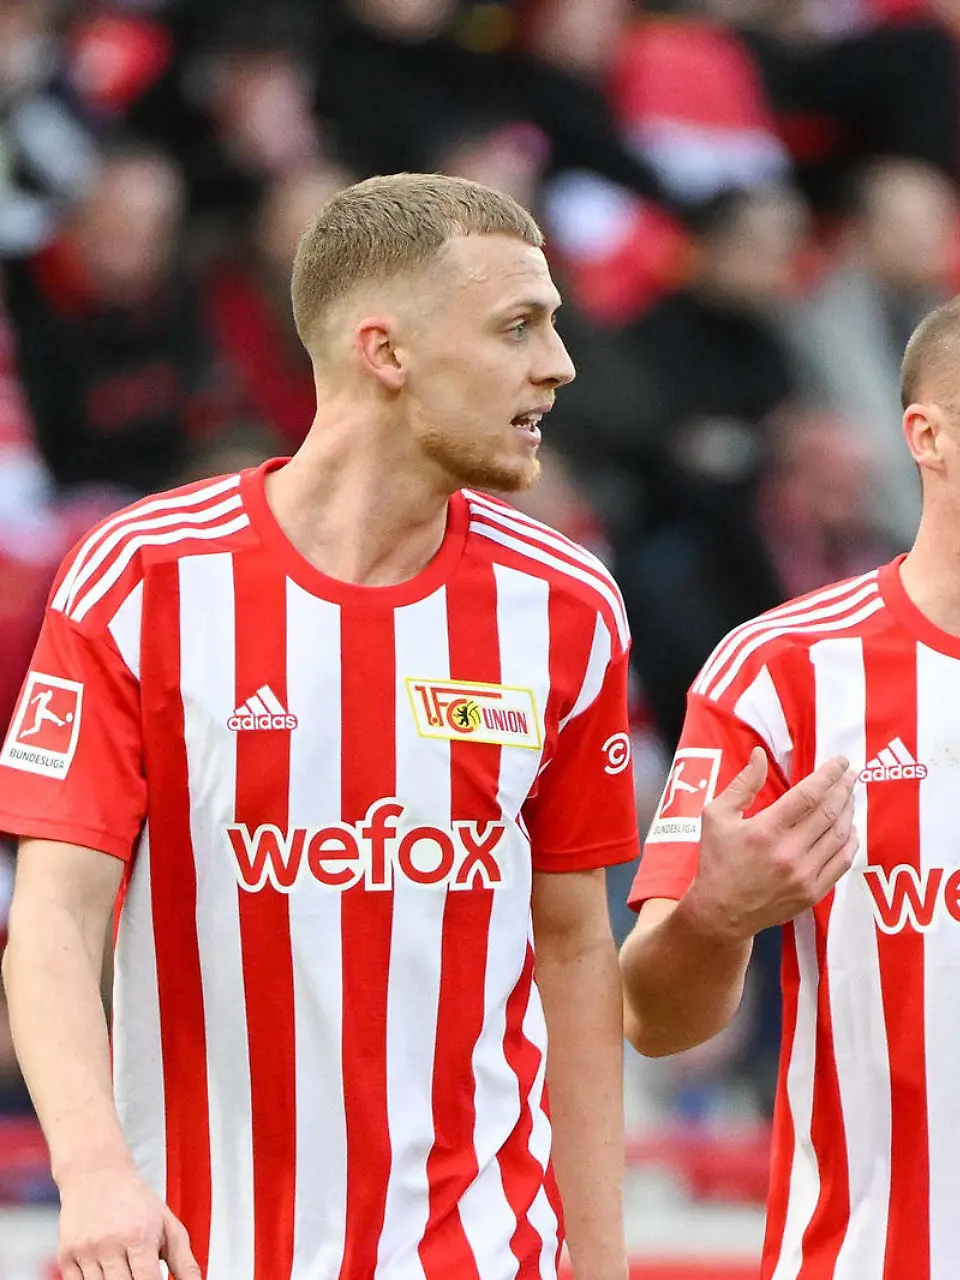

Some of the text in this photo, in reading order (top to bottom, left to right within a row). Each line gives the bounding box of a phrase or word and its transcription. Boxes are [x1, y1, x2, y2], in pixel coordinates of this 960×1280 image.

[226, 713, 298, 731] adidas
[482, 707, 528, 734] UNION
[9, 747, 65, 769] BUNDESLIGA
[859, 764, 928, 783] adidas
[227, 798, 506, 891] wefox
